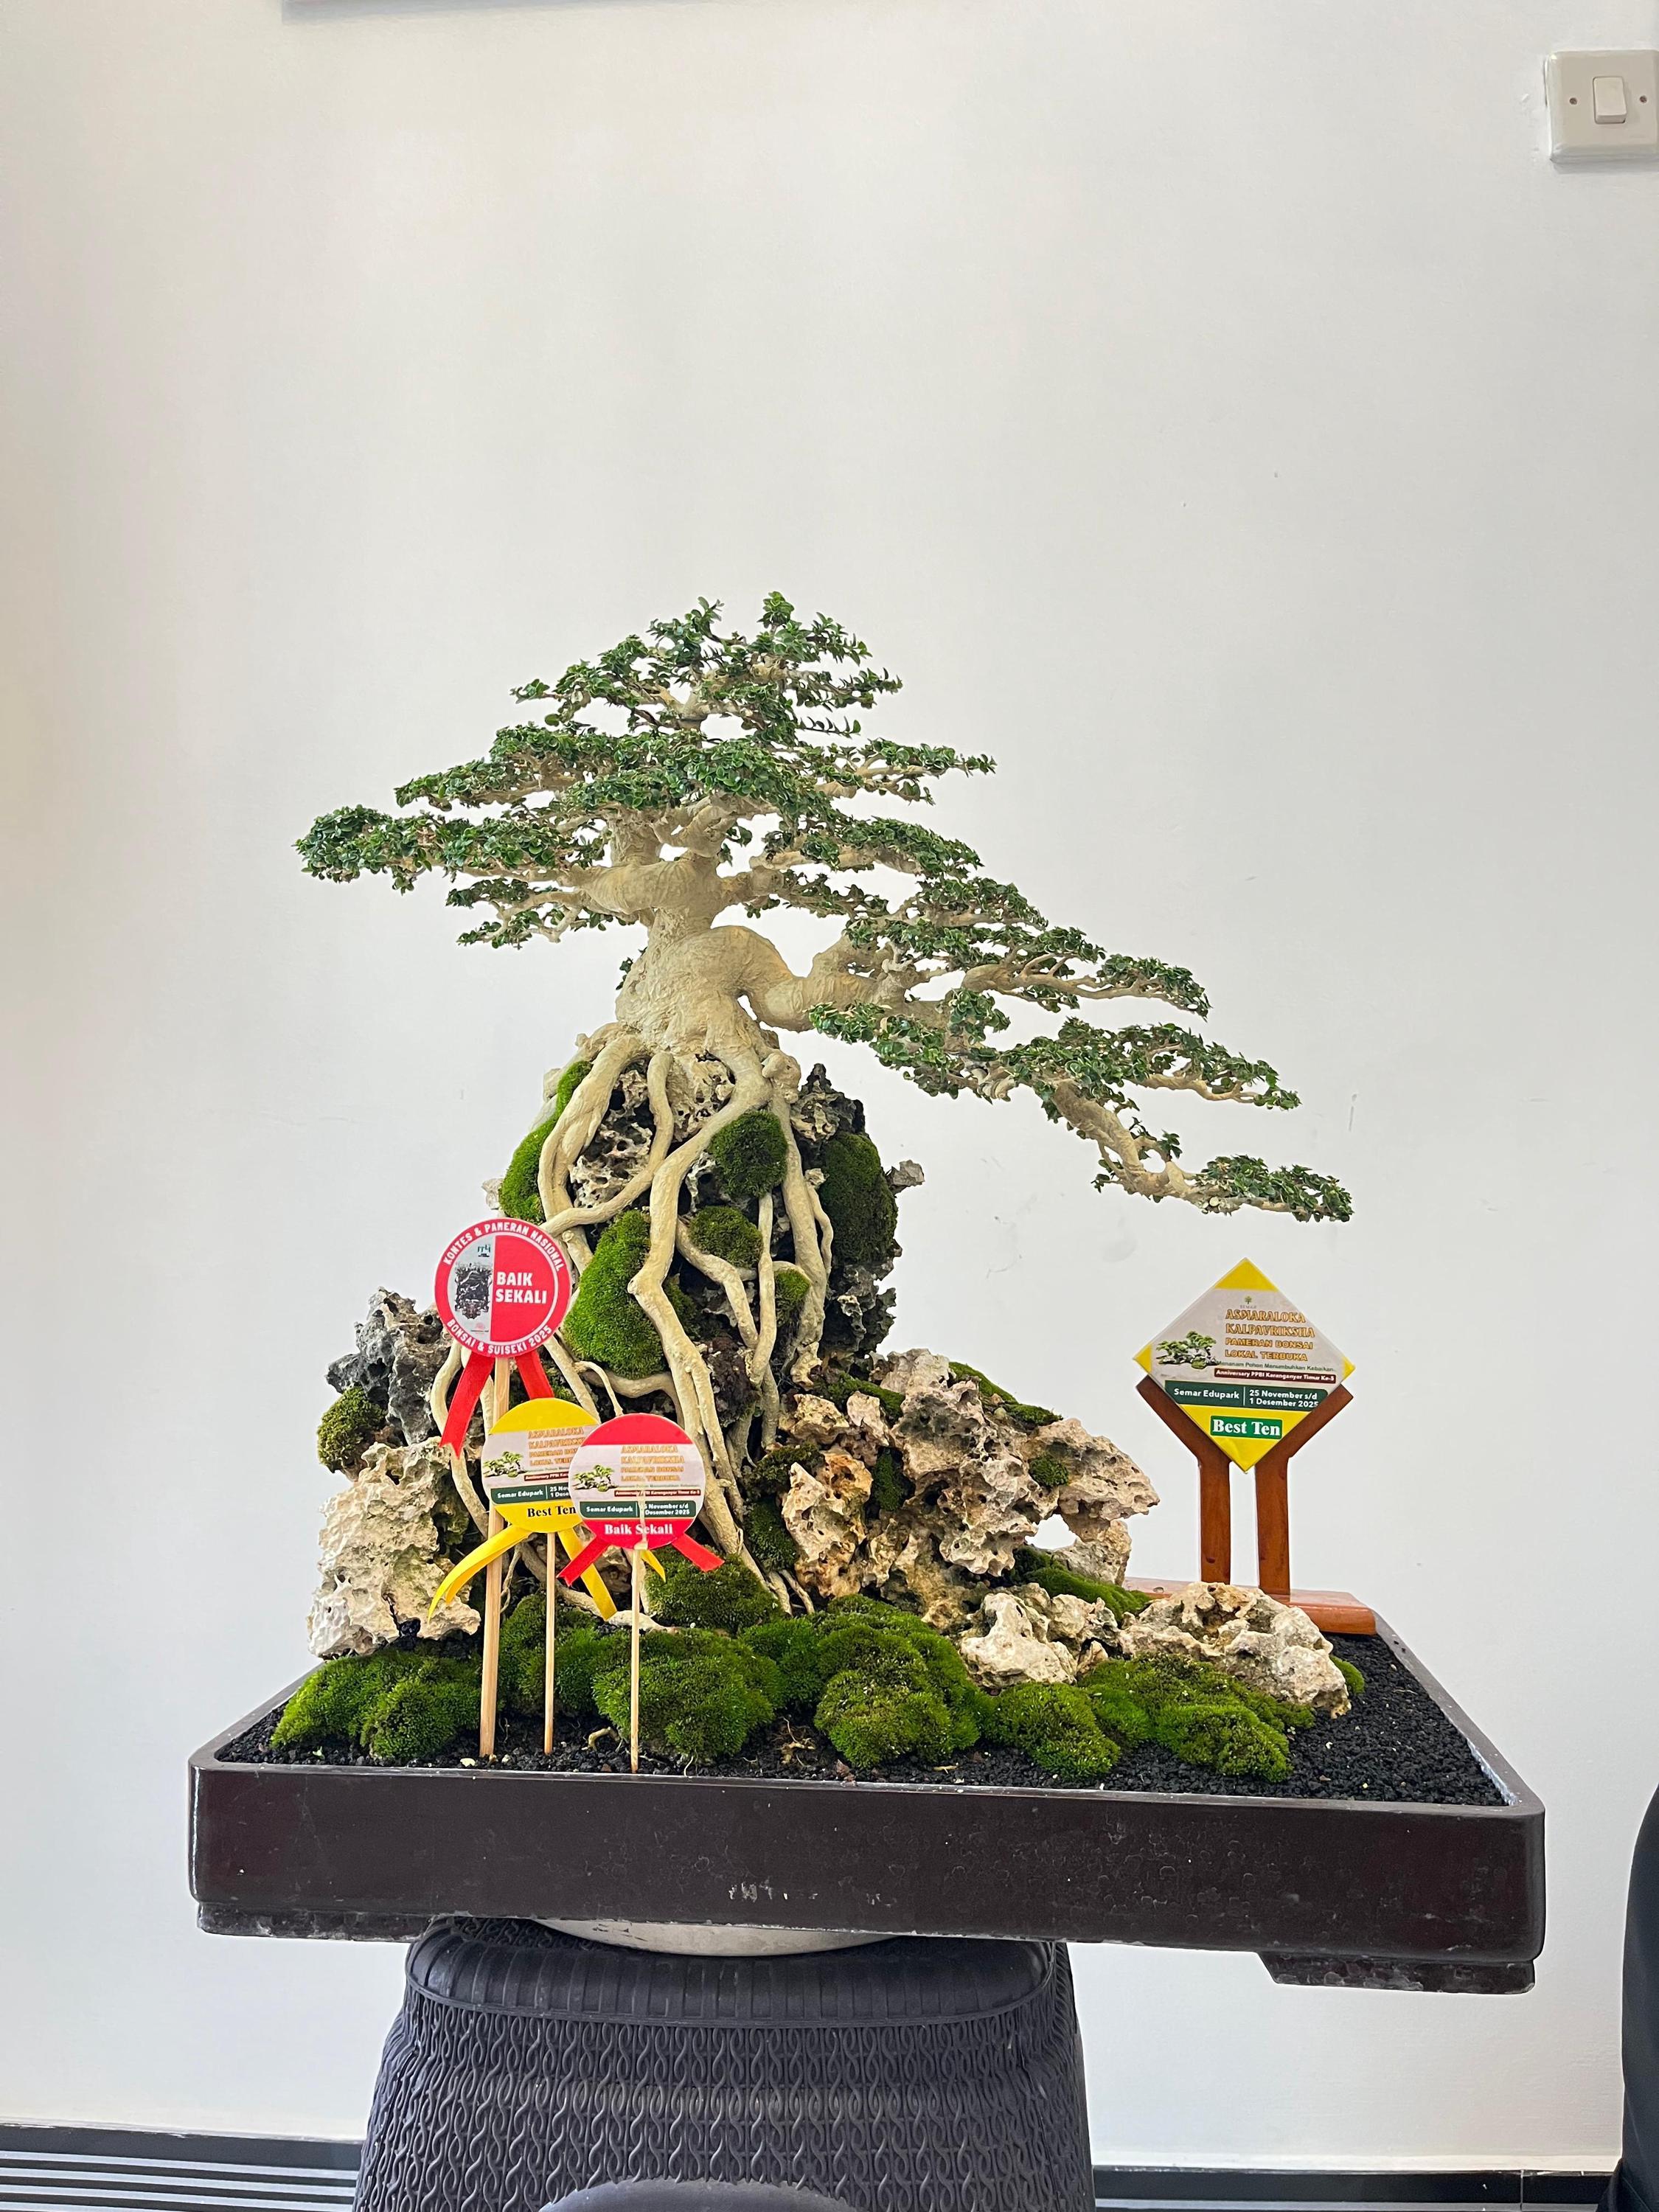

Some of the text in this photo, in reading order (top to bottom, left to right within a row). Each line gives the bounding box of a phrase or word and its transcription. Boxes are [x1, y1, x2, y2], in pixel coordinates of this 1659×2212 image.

[443, 1233, 473, 1265] KONTES
[474, 1227, 483, 1236] &
[484, 1222, 529, 1235] PAMERAN
[530, 1230, 566, 1271] NASIONAL
[496, 1271, 533, 1287] BAIK
[495, 1288, 547, 1304] SEKALI
[1225, 1309, 1307, 1324] ASMARALOKA
[447, 1318, 552, 1354] BONSAI & SUISEKI 2025
[1225, 1324, 1315, 1338] KALPAVRIKSHA
[1225, 1338, 1313, 1350] PAMERAN BONSAI
[1225, 1349, 1308, 1361] LOKAL TERBUKA
[1216, 1369, 1250, 1377] Anniversary
[1265, 1372, 1302, 1380] Karanganyar
[1174, 1388, 1239, 1399] Semar Edupark
[1261, 1391, 1302, 1399] November
[1256, 1398, 1296, 1407] Desember
[1211, 1419, 1281, 1436] Best Ten
[518, 1489, 543, 1498] Edupark
[527, 1505, 577, 1517] Best Ten
[605, 1523, 673, 1535] Baik Sekali
